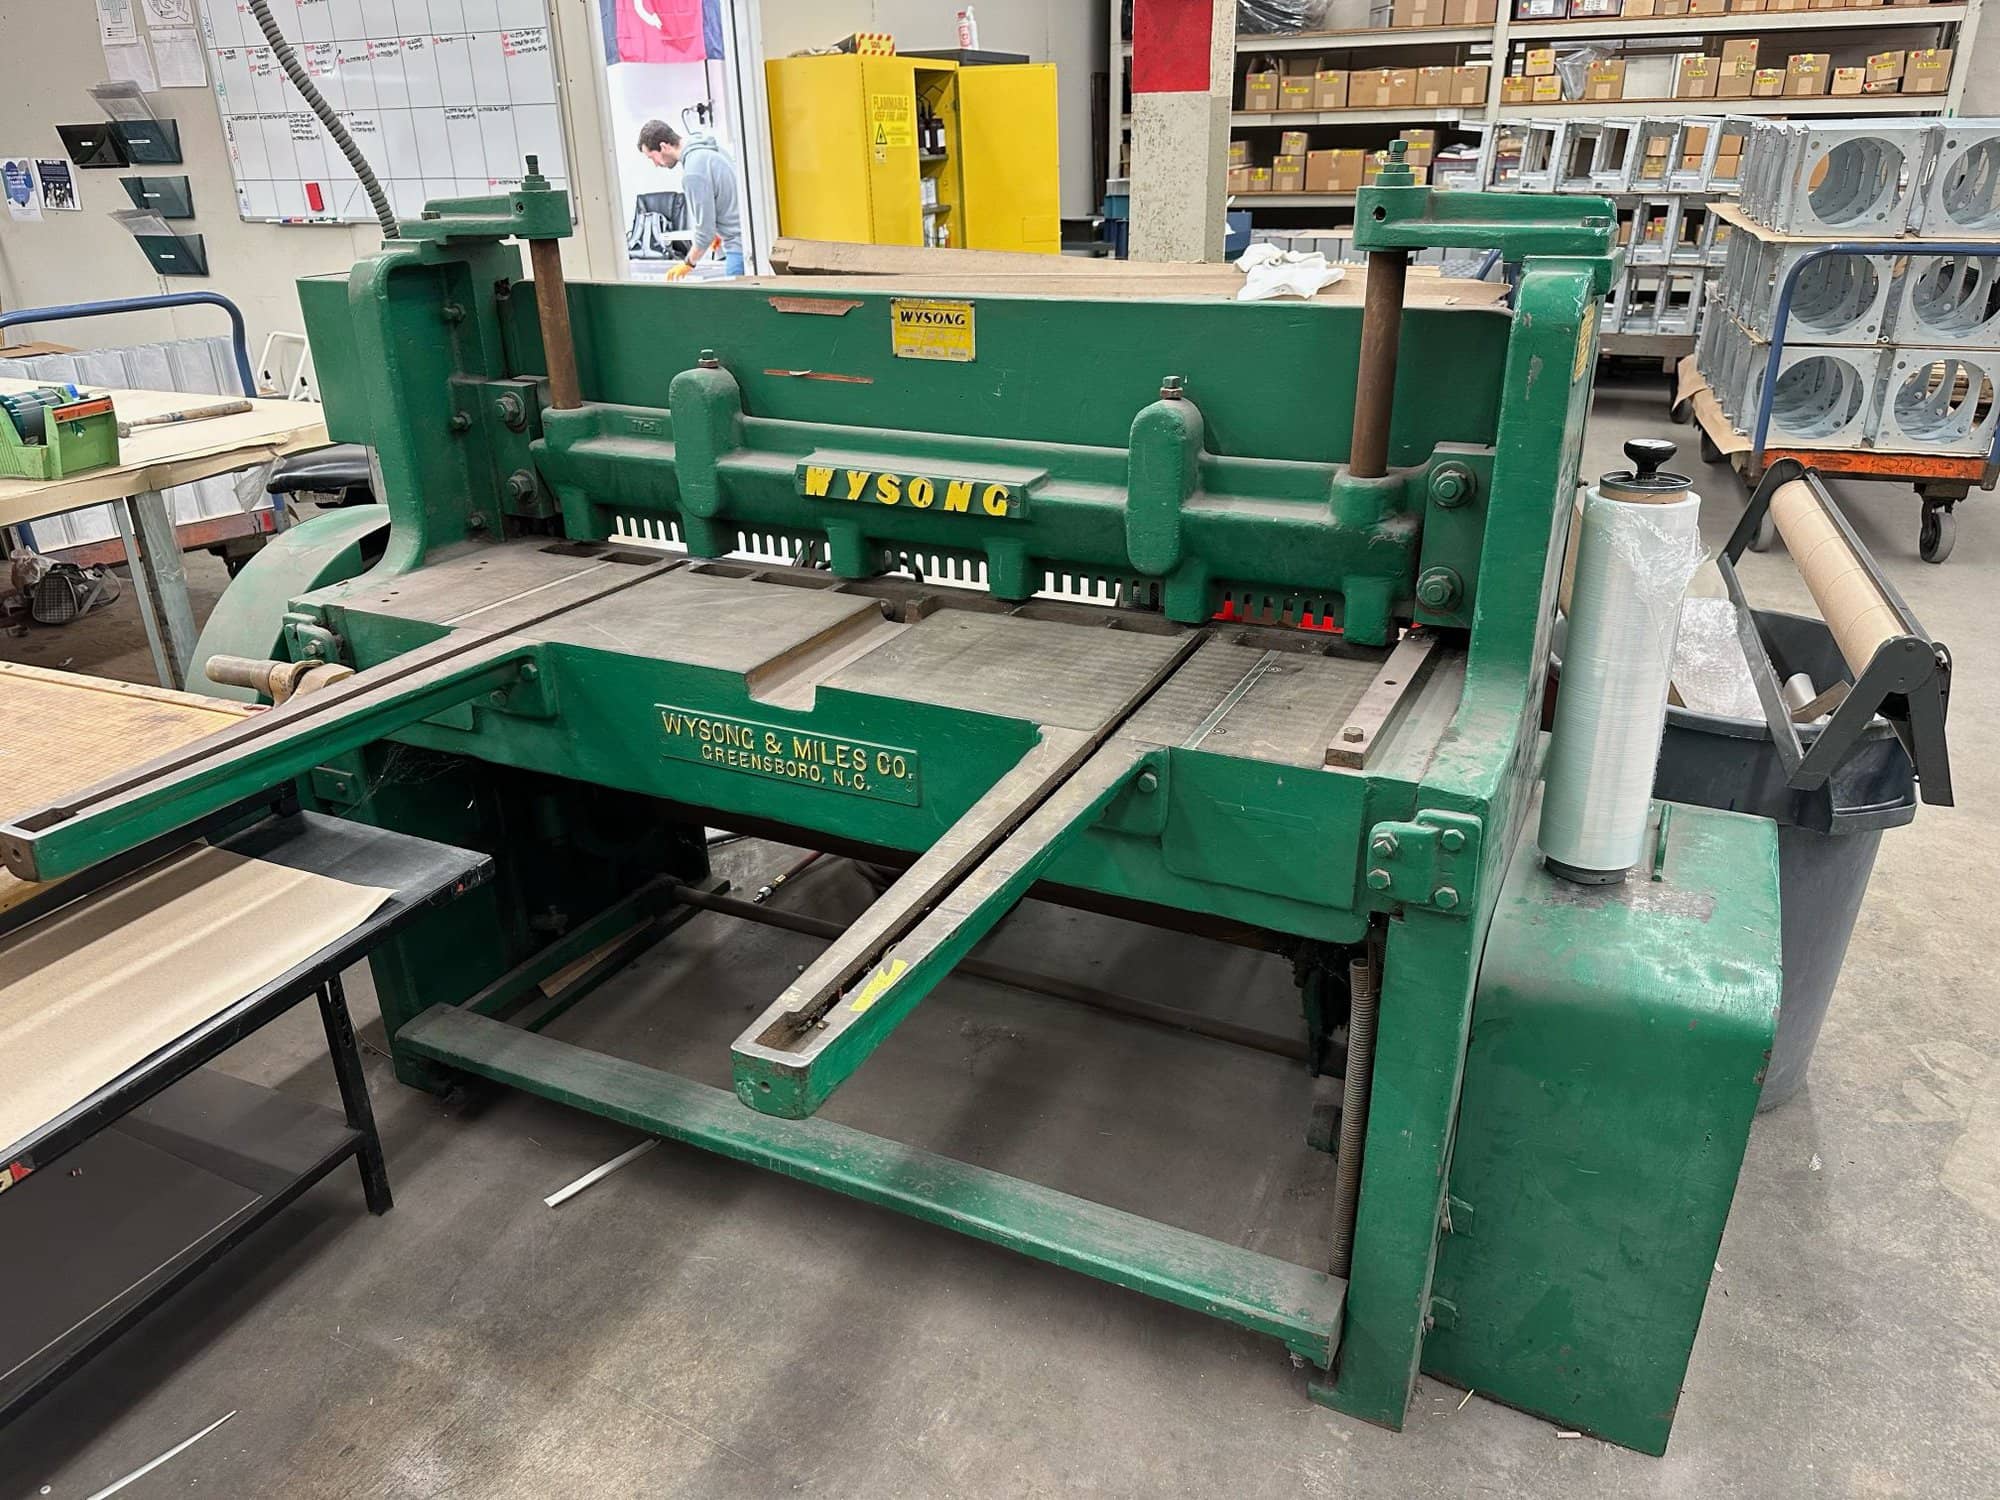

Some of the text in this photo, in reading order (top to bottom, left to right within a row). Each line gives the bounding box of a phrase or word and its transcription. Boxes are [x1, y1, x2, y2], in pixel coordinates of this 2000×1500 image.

[873, 96, 908, 111] FLAMMABLE
[900, 311, 966, 325] WYSONG
[805, 466, 1009, 516] WYSONG
[661, 711, 915, 780] WYSONG & MILES CO.
[701, 744, 827, 784] GREENSBORO,
